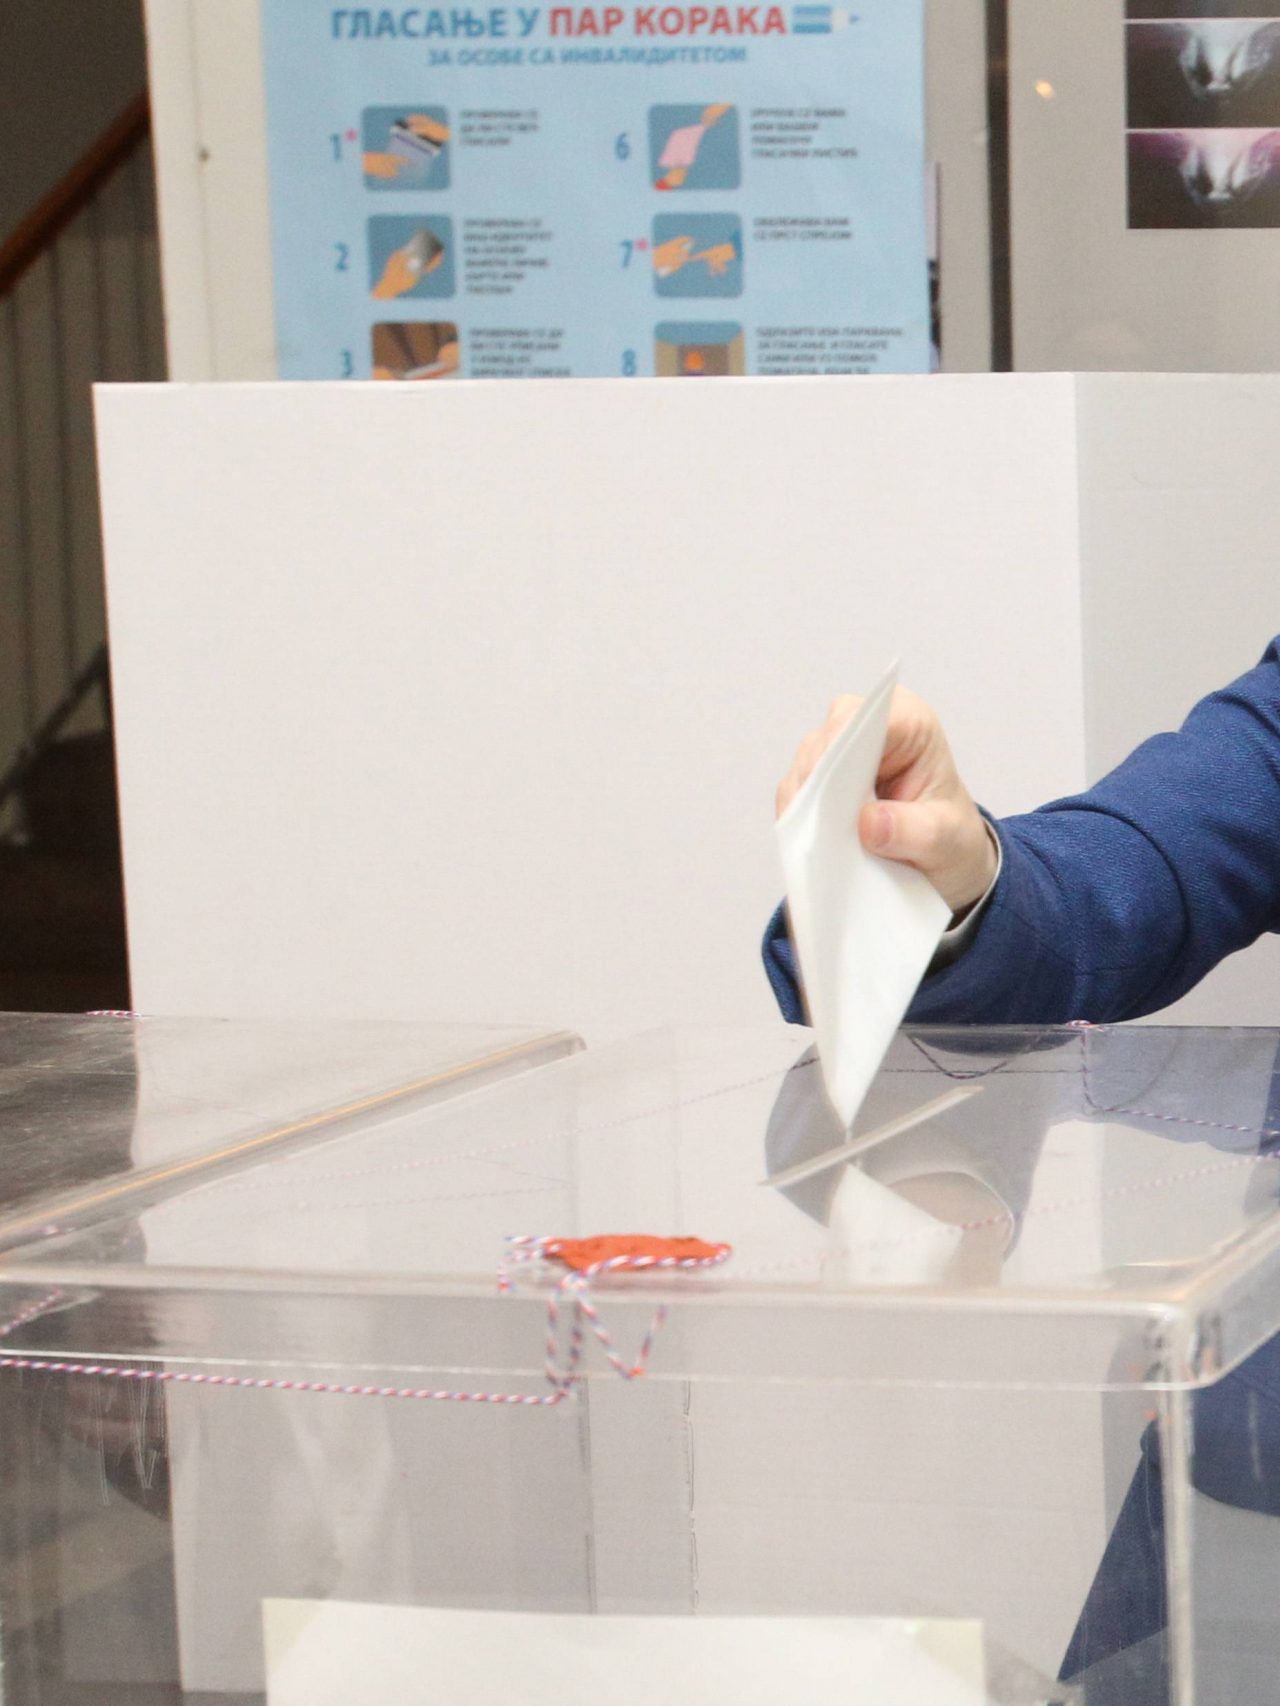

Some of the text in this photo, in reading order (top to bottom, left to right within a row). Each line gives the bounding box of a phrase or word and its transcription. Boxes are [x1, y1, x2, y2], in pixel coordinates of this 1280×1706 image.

[332, 6, 787, 39] ГЛАСАЊЕ У ПАР КОРАКА
[428, 46, 747, 65] ЗА ОСОБЕ СА ИНВАЛИДИТЕТОМ
[615, 132, 630, 161] 6
[334, 240, 349, 272] 2
[620, 239, 634, 268] 7
[341, 348, 355, 378] 3
[622, 348, 637, 377] 8
